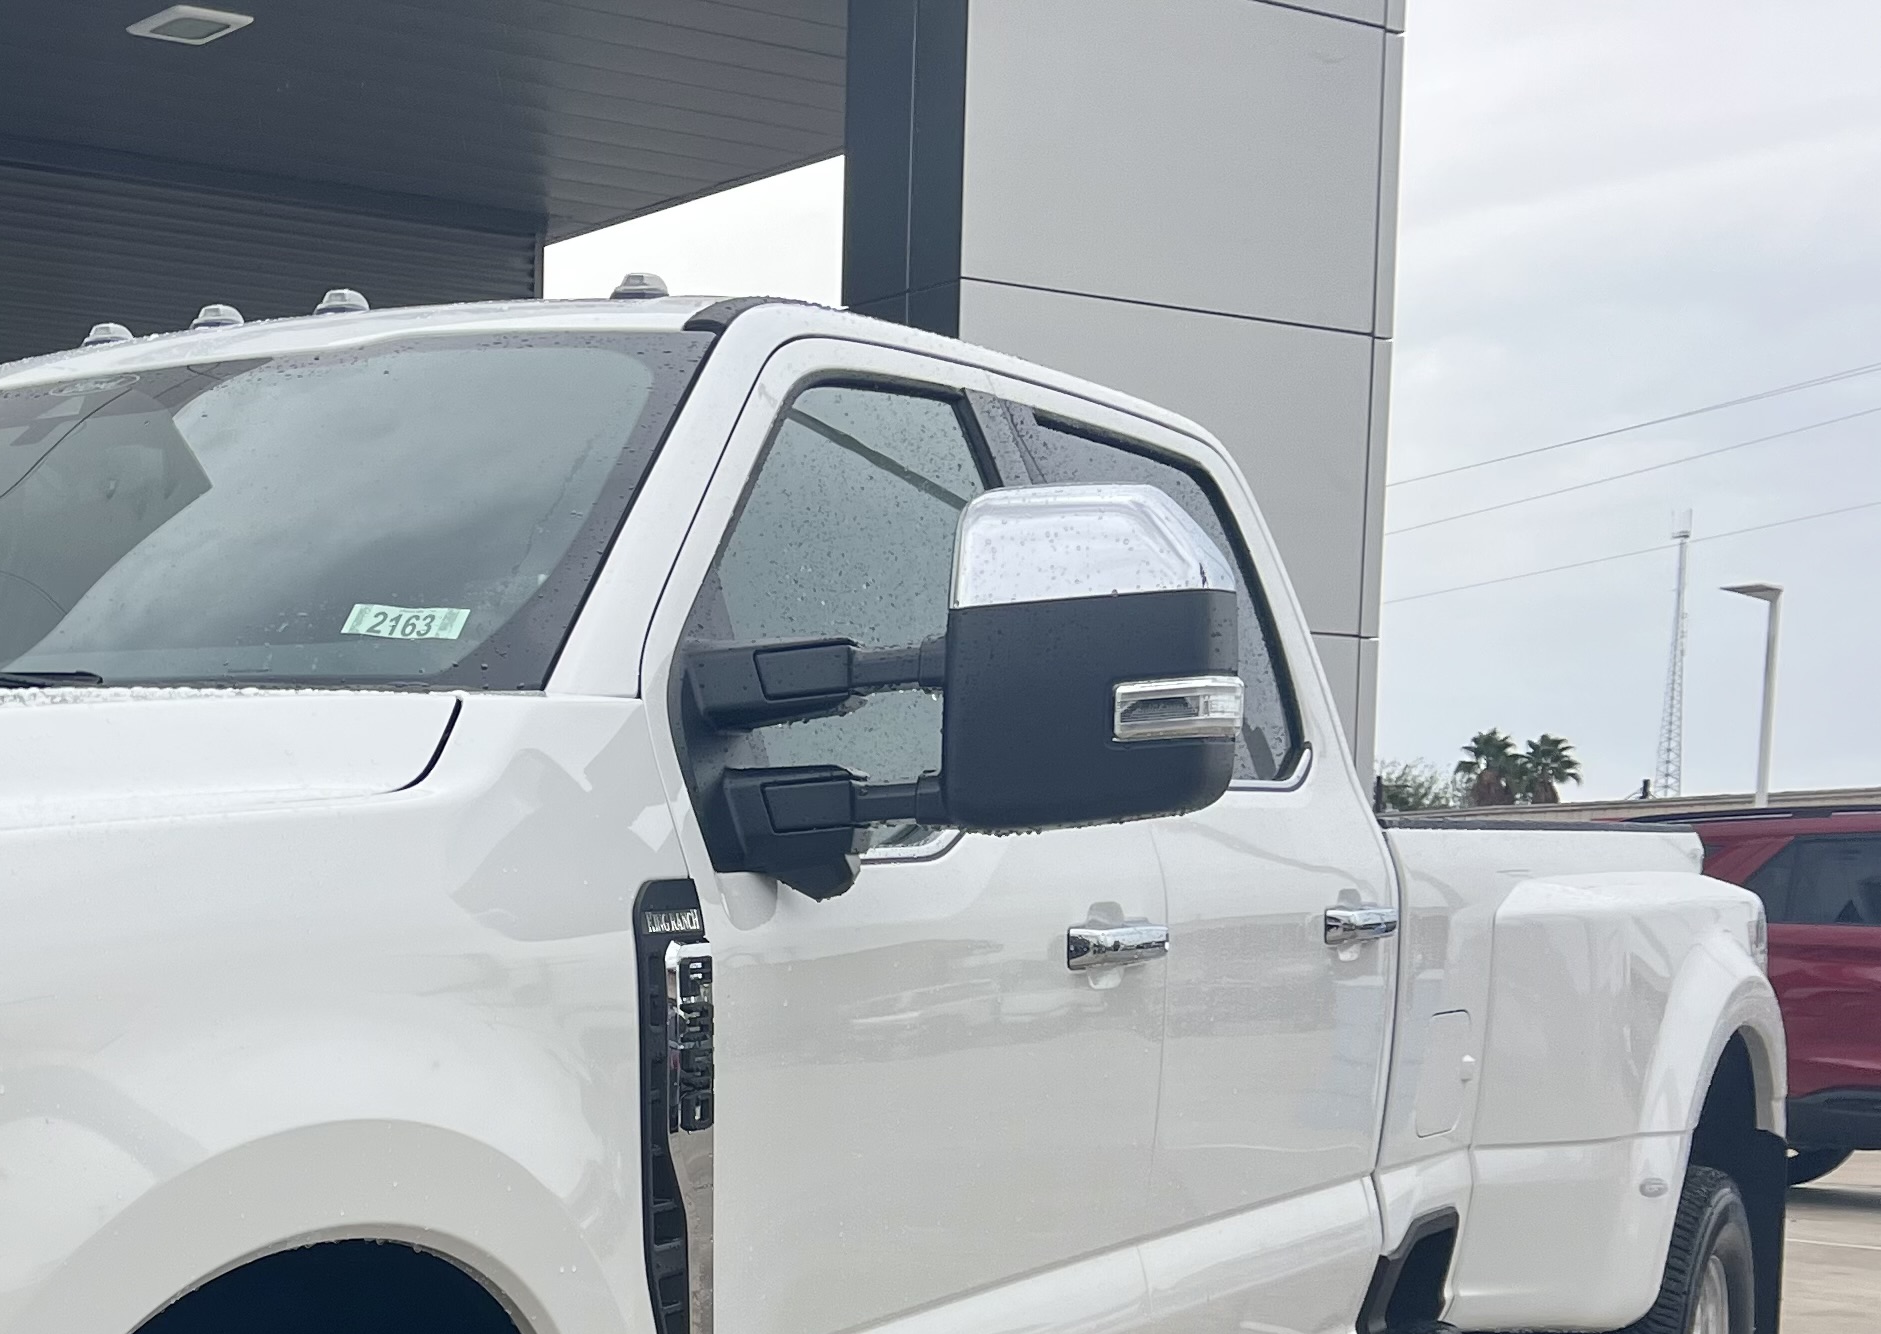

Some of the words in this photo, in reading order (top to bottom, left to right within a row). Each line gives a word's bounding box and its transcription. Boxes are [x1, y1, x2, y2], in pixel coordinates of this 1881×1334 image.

[365, 611, 435, 637] 2163
[646, 911, 670, 933] KING
[669, 909, 700, 931] RANCH
